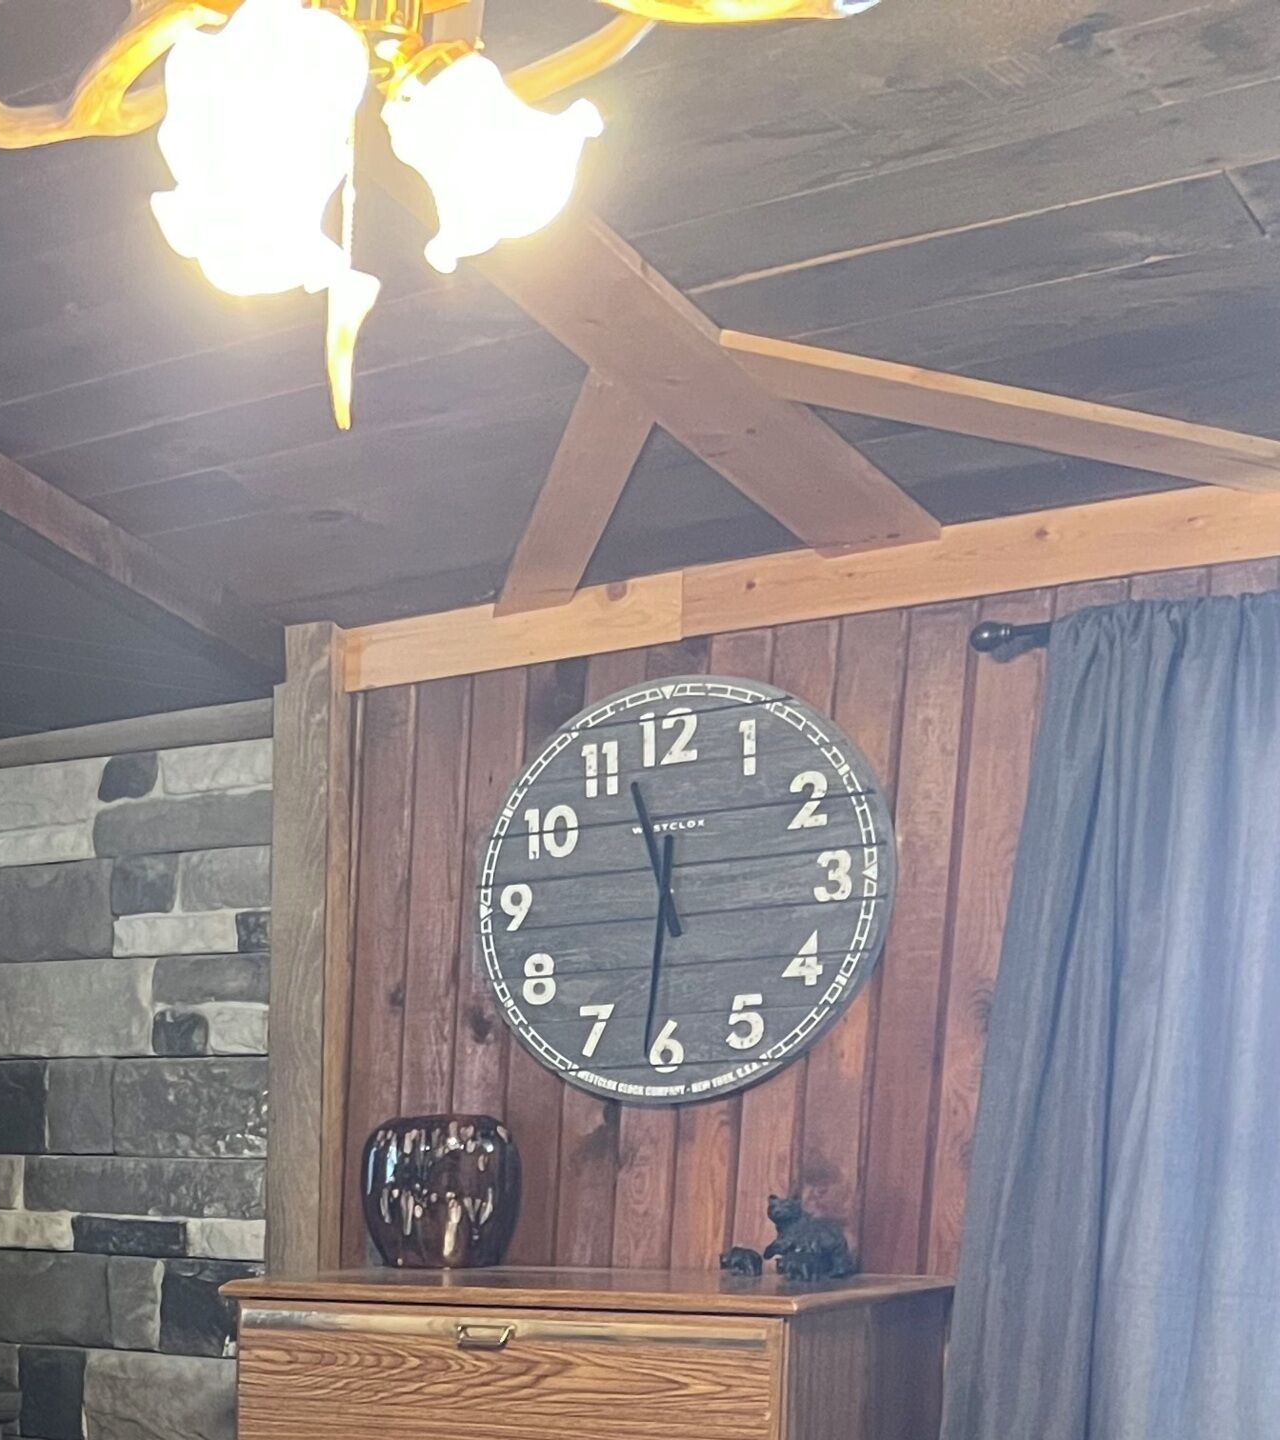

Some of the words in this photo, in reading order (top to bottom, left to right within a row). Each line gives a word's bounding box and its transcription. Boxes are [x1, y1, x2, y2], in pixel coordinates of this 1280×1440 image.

[639, 707, 699, 767] 12
[739, 719, 757, 776] 1
[581, 741, 619, 798] 11
[631, 819, 705, 835] WSTCLOX
[787, 770, 829, 830] 2
[524, 804, 579, 860] 10
[813, 850, 852, 903] 3
[500, 884, 533, 932] 9
[522, 953, 556, 1006] 8
[781, 929, 824, 986] 4
[579, 1004, 615, 1058] 7
[649, 1019, 685, 1074] 6
[725, 993, 765, 1051] 5
